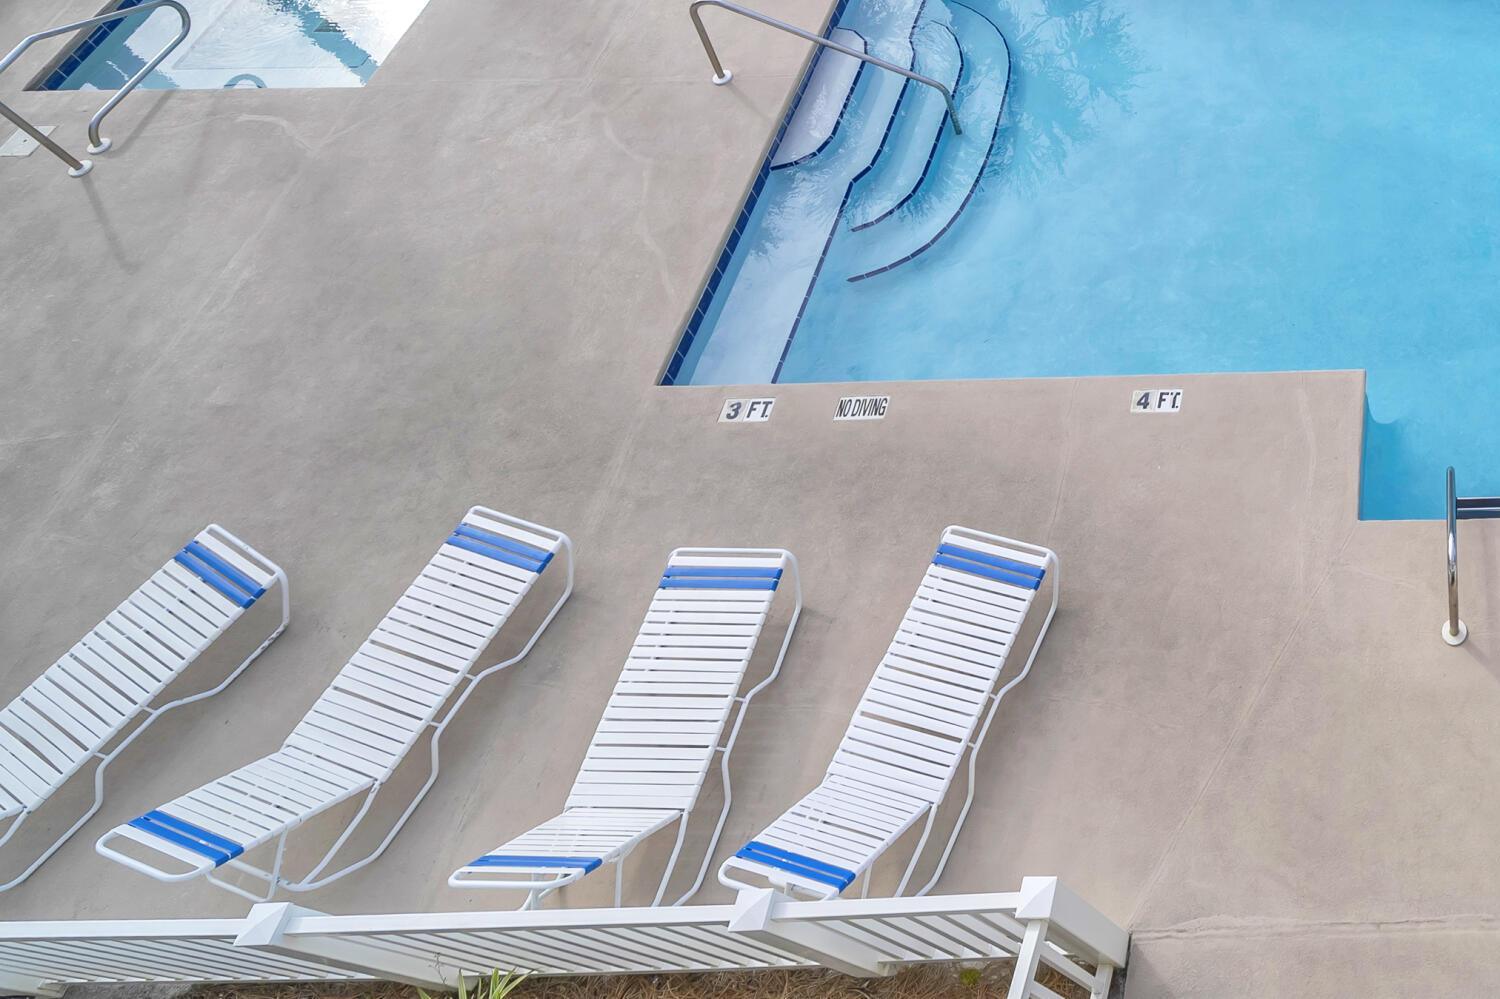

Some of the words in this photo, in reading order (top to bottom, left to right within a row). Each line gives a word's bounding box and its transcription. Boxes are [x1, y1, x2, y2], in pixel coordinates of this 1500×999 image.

[835, 398, 852, 418] NO
[850, 397, 889, 417] DIVING
[1136, 391, 1150, 410] 4
[726, 401, 743, 420] 3
